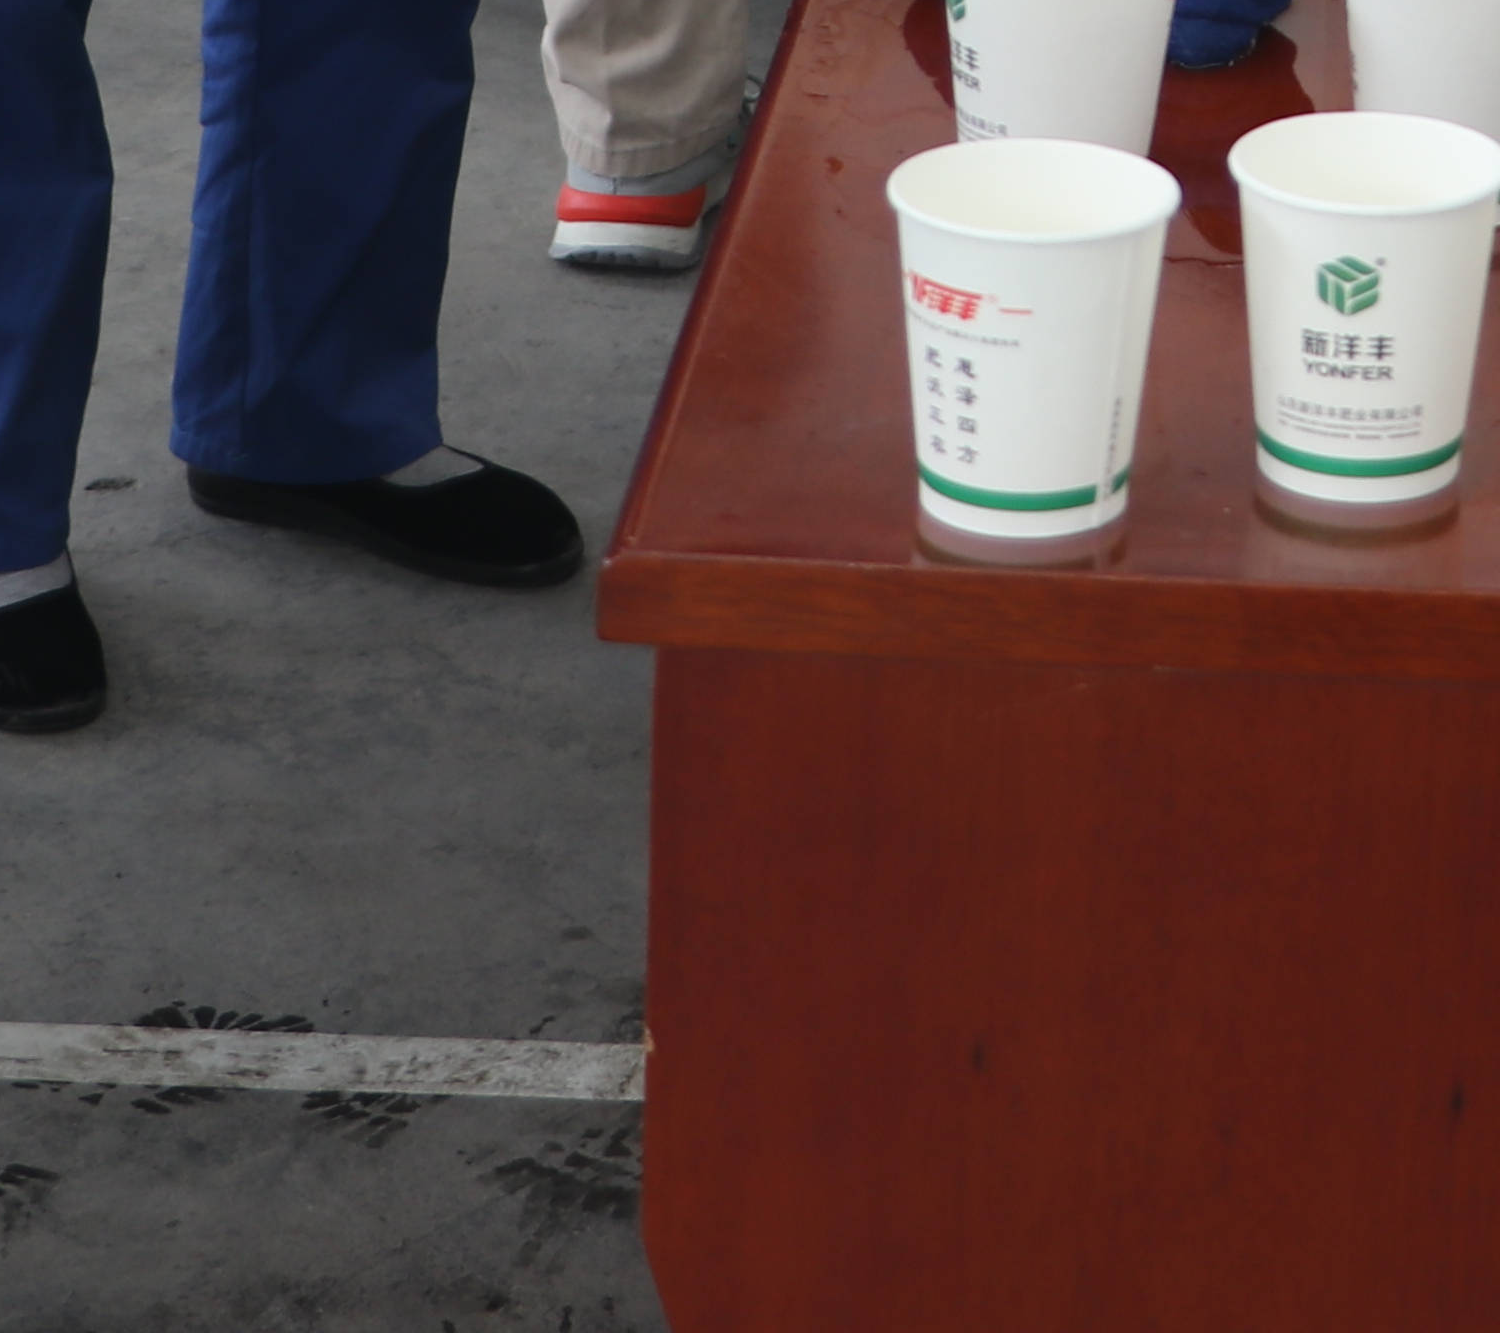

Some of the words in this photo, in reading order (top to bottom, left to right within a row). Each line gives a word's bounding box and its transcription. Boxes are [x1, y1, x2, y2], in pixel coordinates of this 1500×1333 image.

[1302, 329, 1394, 360] 新洋丰
[1303, 359, 1394, 381] YONFER
